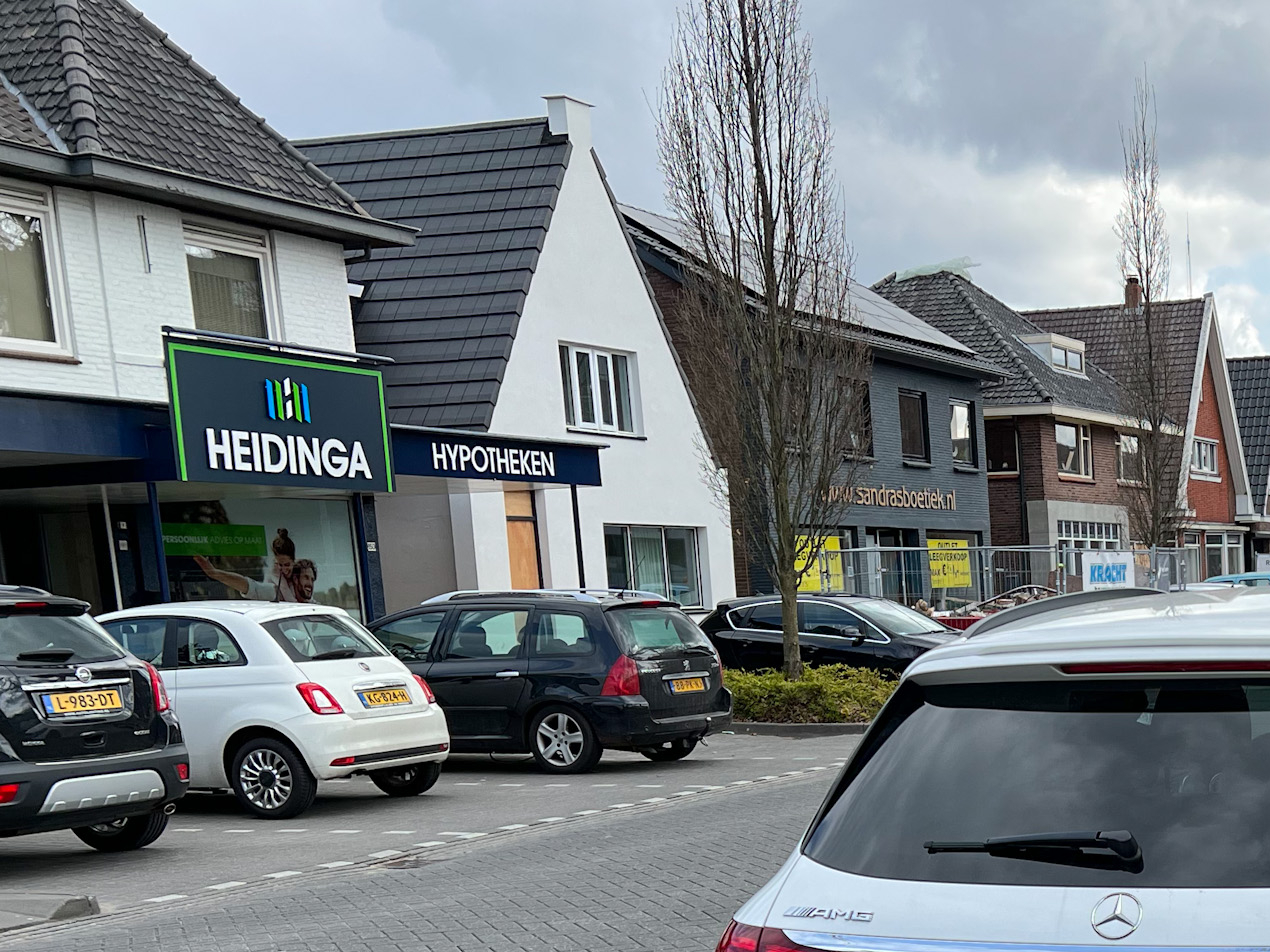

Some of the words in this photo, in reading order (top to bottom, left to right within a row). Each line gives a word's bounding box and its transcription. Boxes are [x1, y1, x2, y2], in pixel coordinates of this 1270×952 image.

[205, 427, 373, 480] HEIDINGA
[431, 442, 556, 477] HYPOTHEKEN
[55, 692, 116, 710] L-983-DT
[366, 691, 408, 704] KG-824-H
[807, 907, 874, 922] AMG
